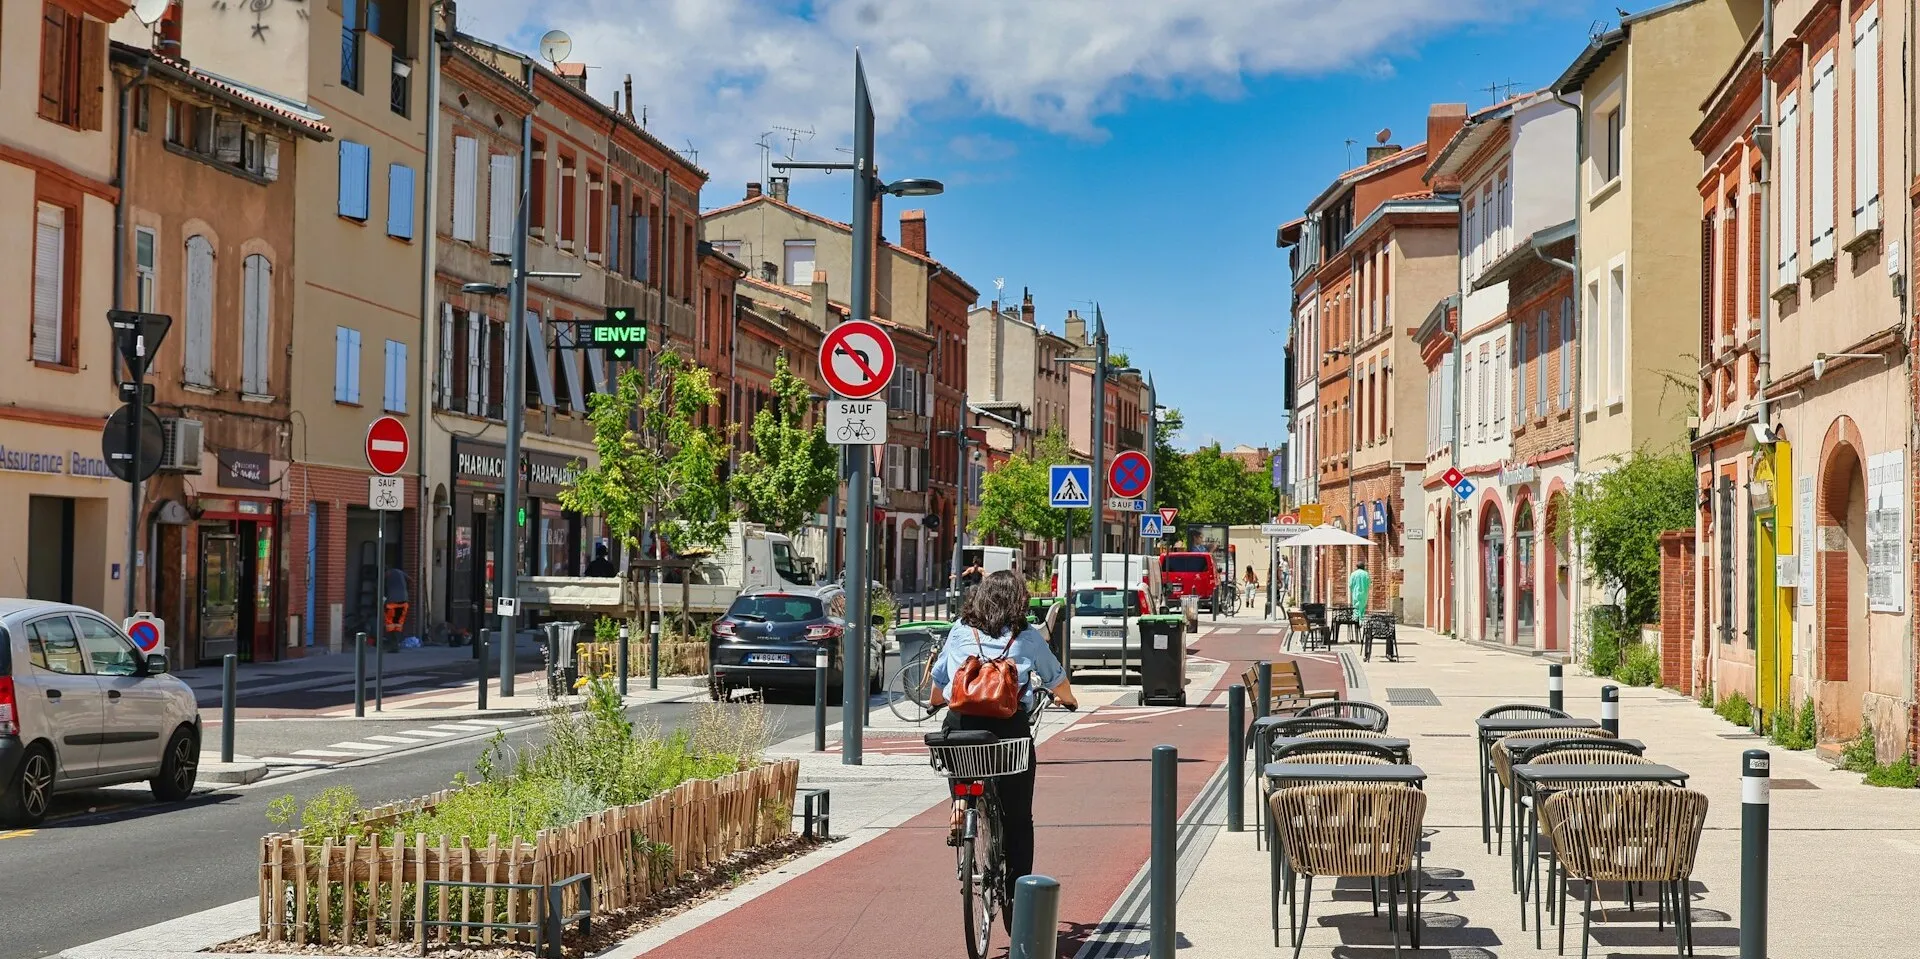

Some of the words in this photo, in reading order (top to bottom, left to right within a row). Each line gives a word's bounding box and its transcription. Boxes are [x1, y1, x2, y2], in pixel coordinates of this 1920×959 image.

[841, 404, 873, 414] SAUF
[0, 444, 63, 474] Assurance
[378, 479, 396, 488] SAUF
